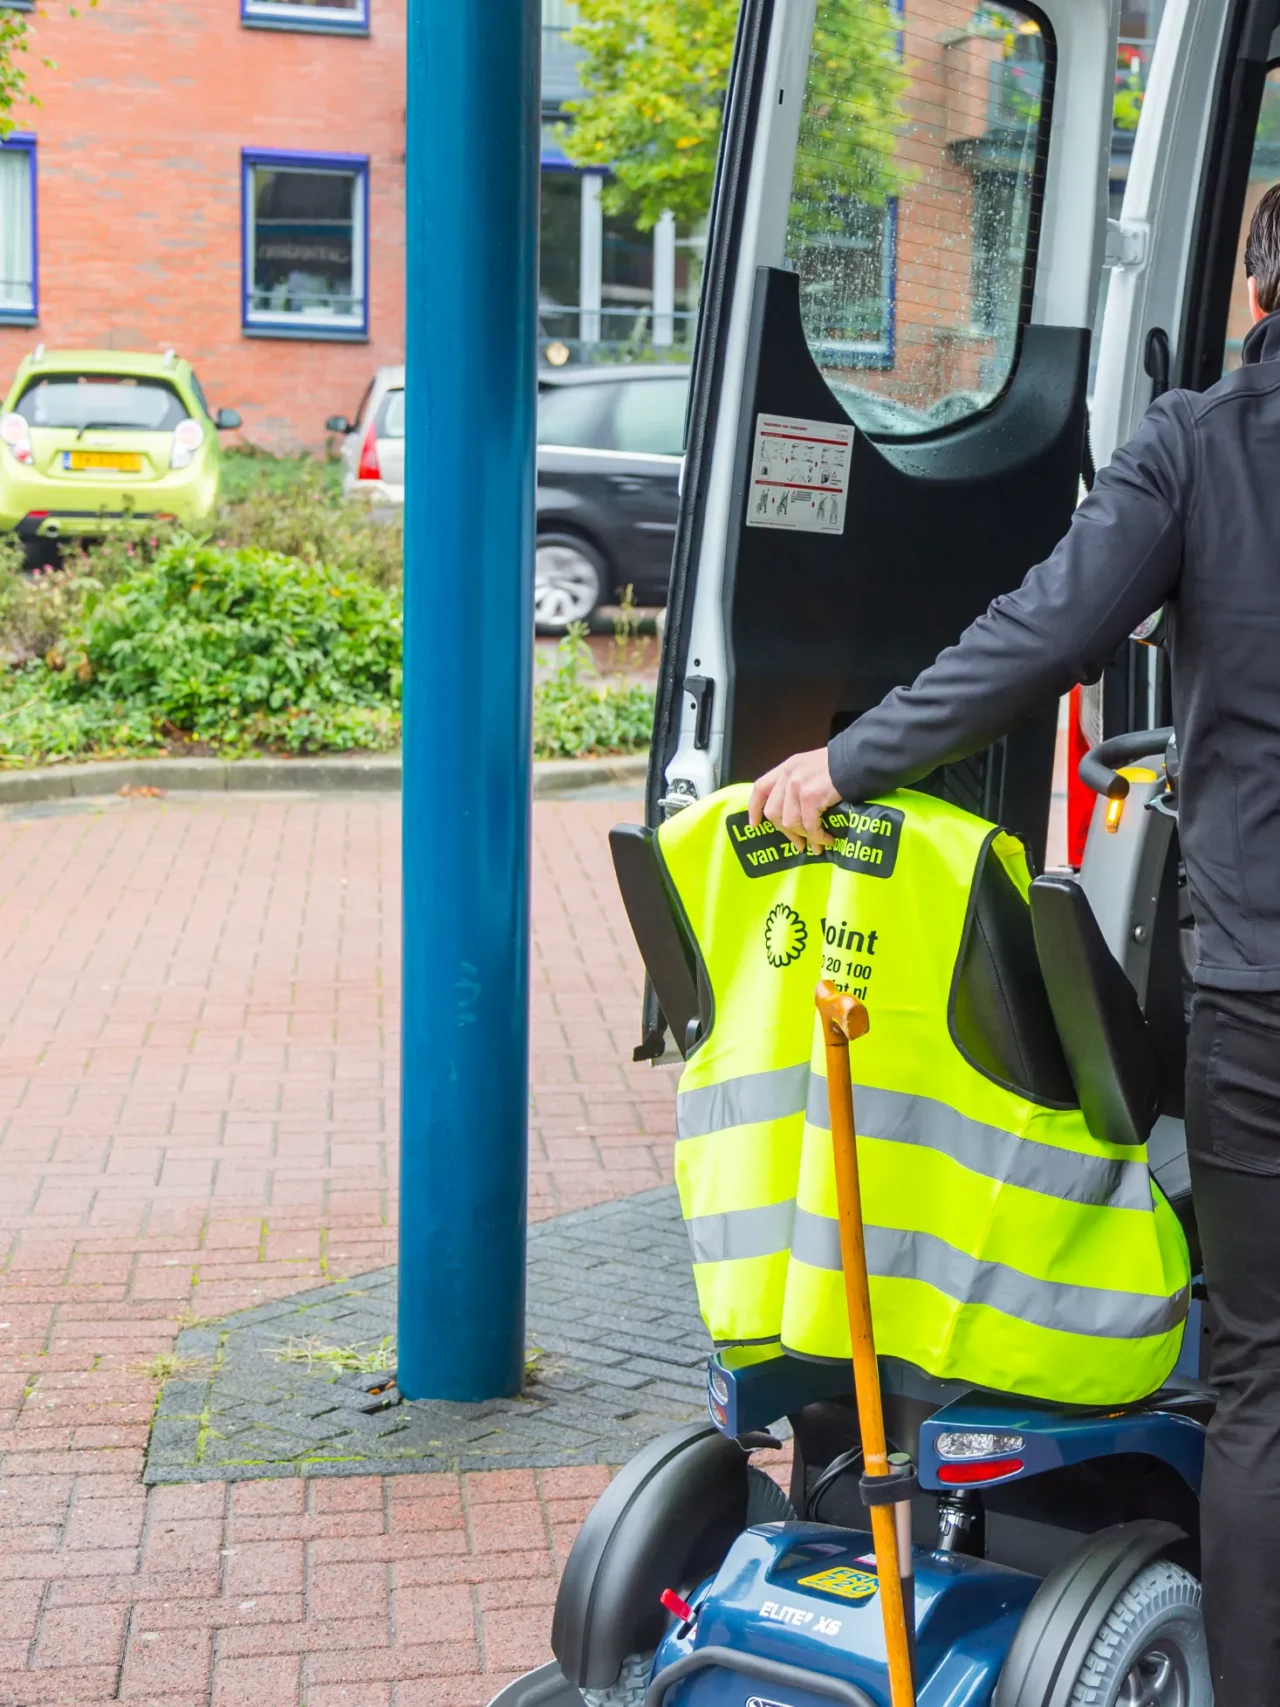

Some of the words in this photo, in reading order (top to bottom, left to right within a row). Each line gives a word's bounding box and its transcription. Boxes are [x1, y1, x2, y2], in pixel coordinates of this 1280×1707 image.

[848, 809, 892, 837] open
[746, 846, 780, 867] van
[825, 956, 842, 974] 20
[846, 961, 872, 980] 100
[812, 1616, 842, 1635] XS
